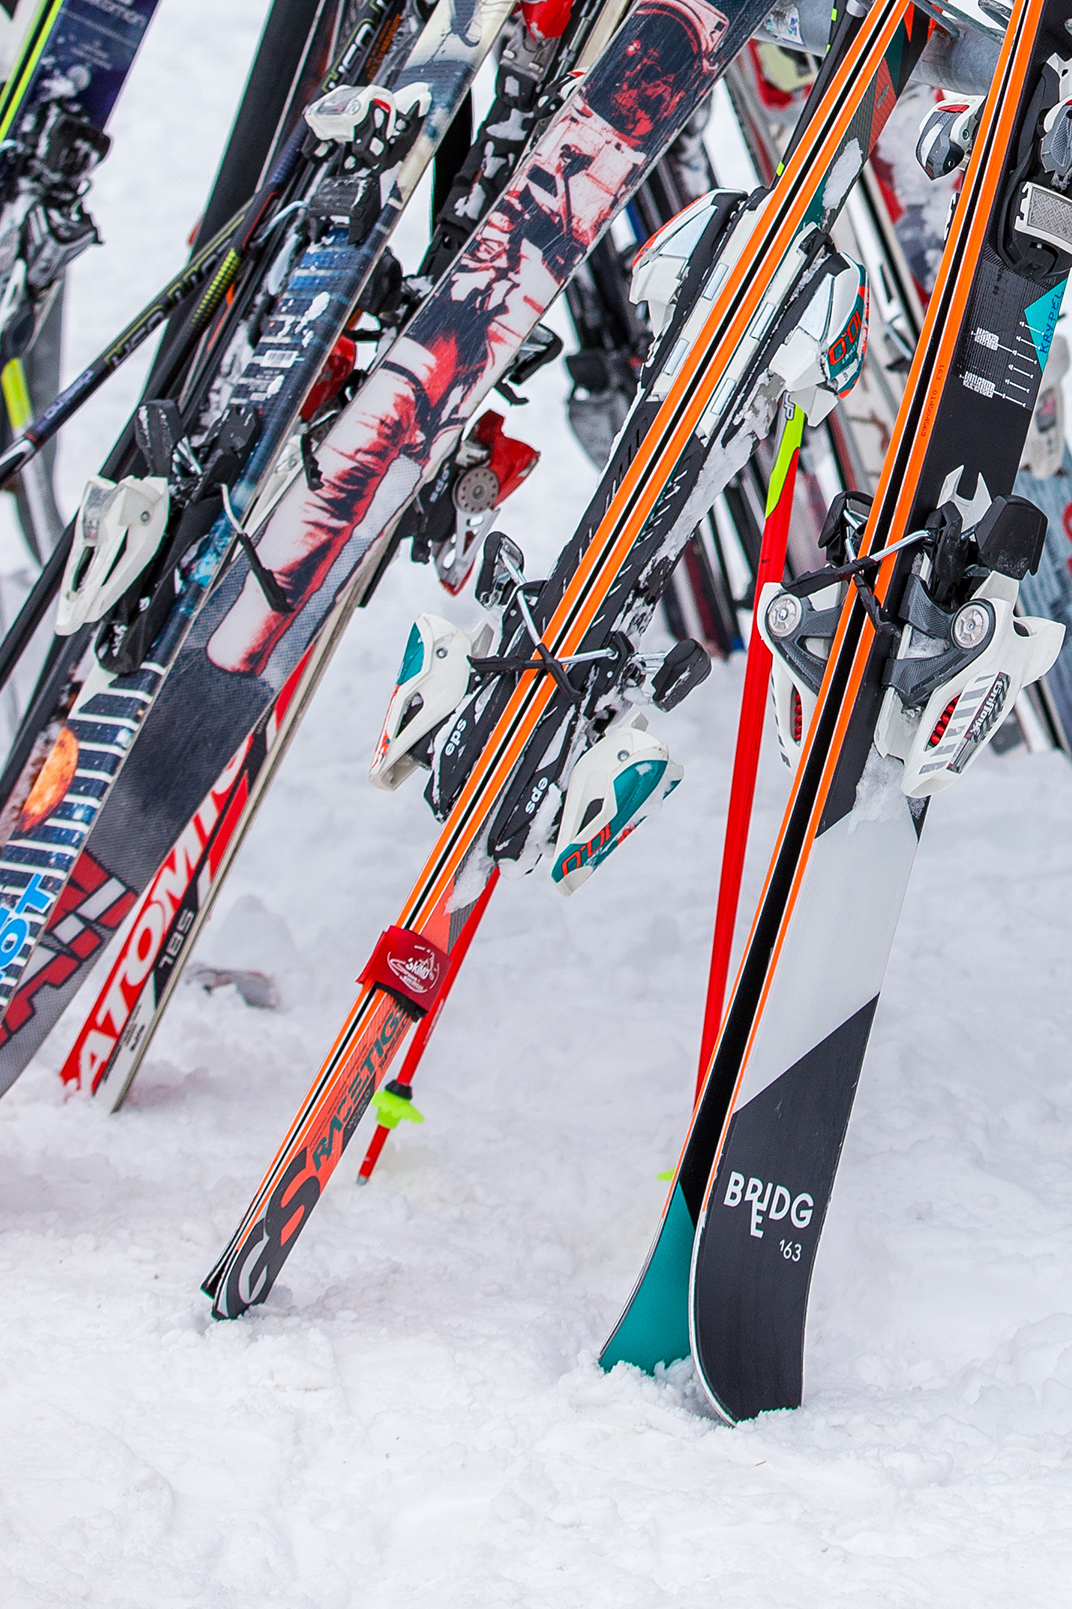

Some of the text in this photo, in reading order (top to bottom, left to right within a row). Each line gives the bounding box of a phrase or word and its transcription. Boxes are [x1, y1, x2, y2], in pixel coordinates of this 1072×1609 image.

[443, 719, 469, 756] eps
[523, 775, 550, 816] eps
[70, 742, 251, 1098] ATOMIC
[157, 905, 195, 974] 185
[309, 1003, 410, 1174] RACETIG
[346, 1088, 373, 1130] WORLD
[778, 1238, 803, 1263] 163
